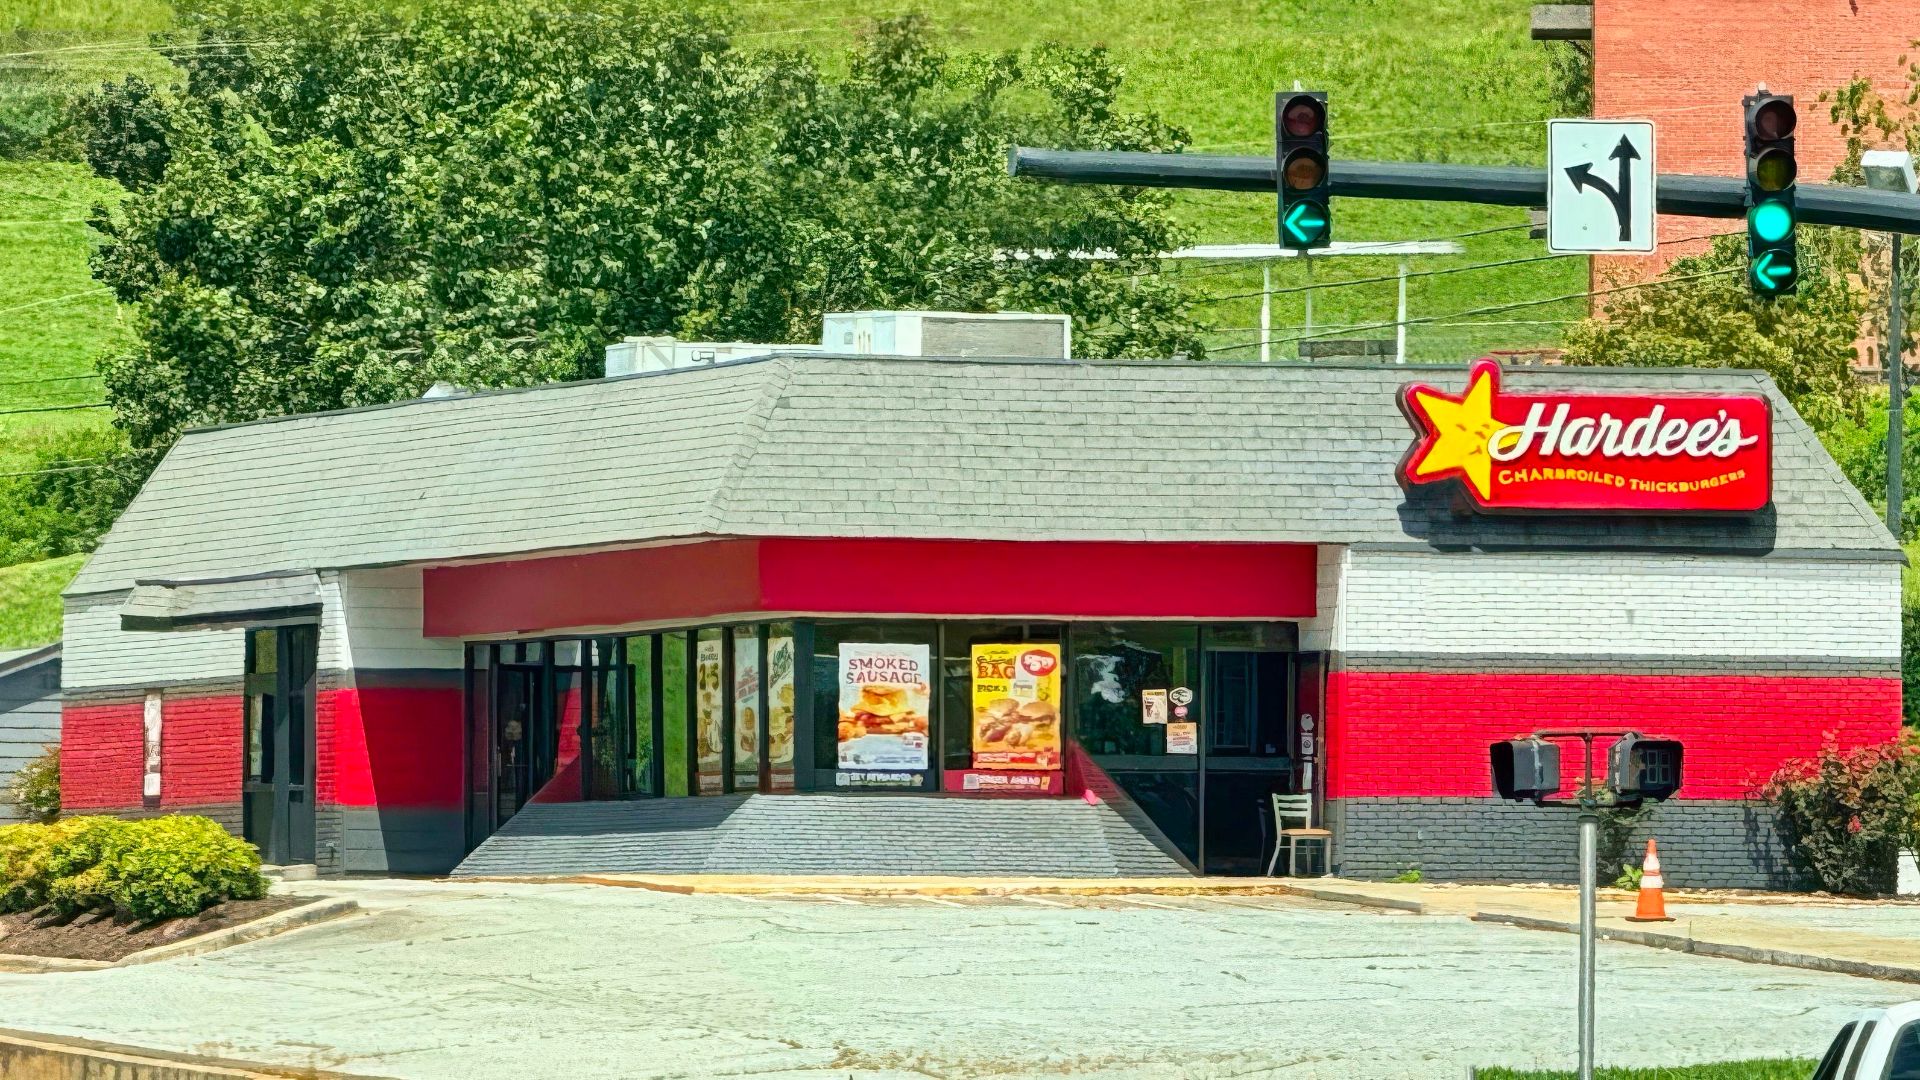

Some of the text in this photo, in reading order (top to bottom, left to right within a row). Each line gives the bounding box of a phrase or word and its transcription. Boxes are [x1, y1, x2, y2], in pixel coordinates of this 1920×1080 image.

[1488, 403, 1758, 461] Hardee's
[1498, 468, 1745, 493] CHARBROILED THICKBURGERS
[849, 657, 919, 671] SMOKED
[846, 671, 922, 684] SAUSAGE
